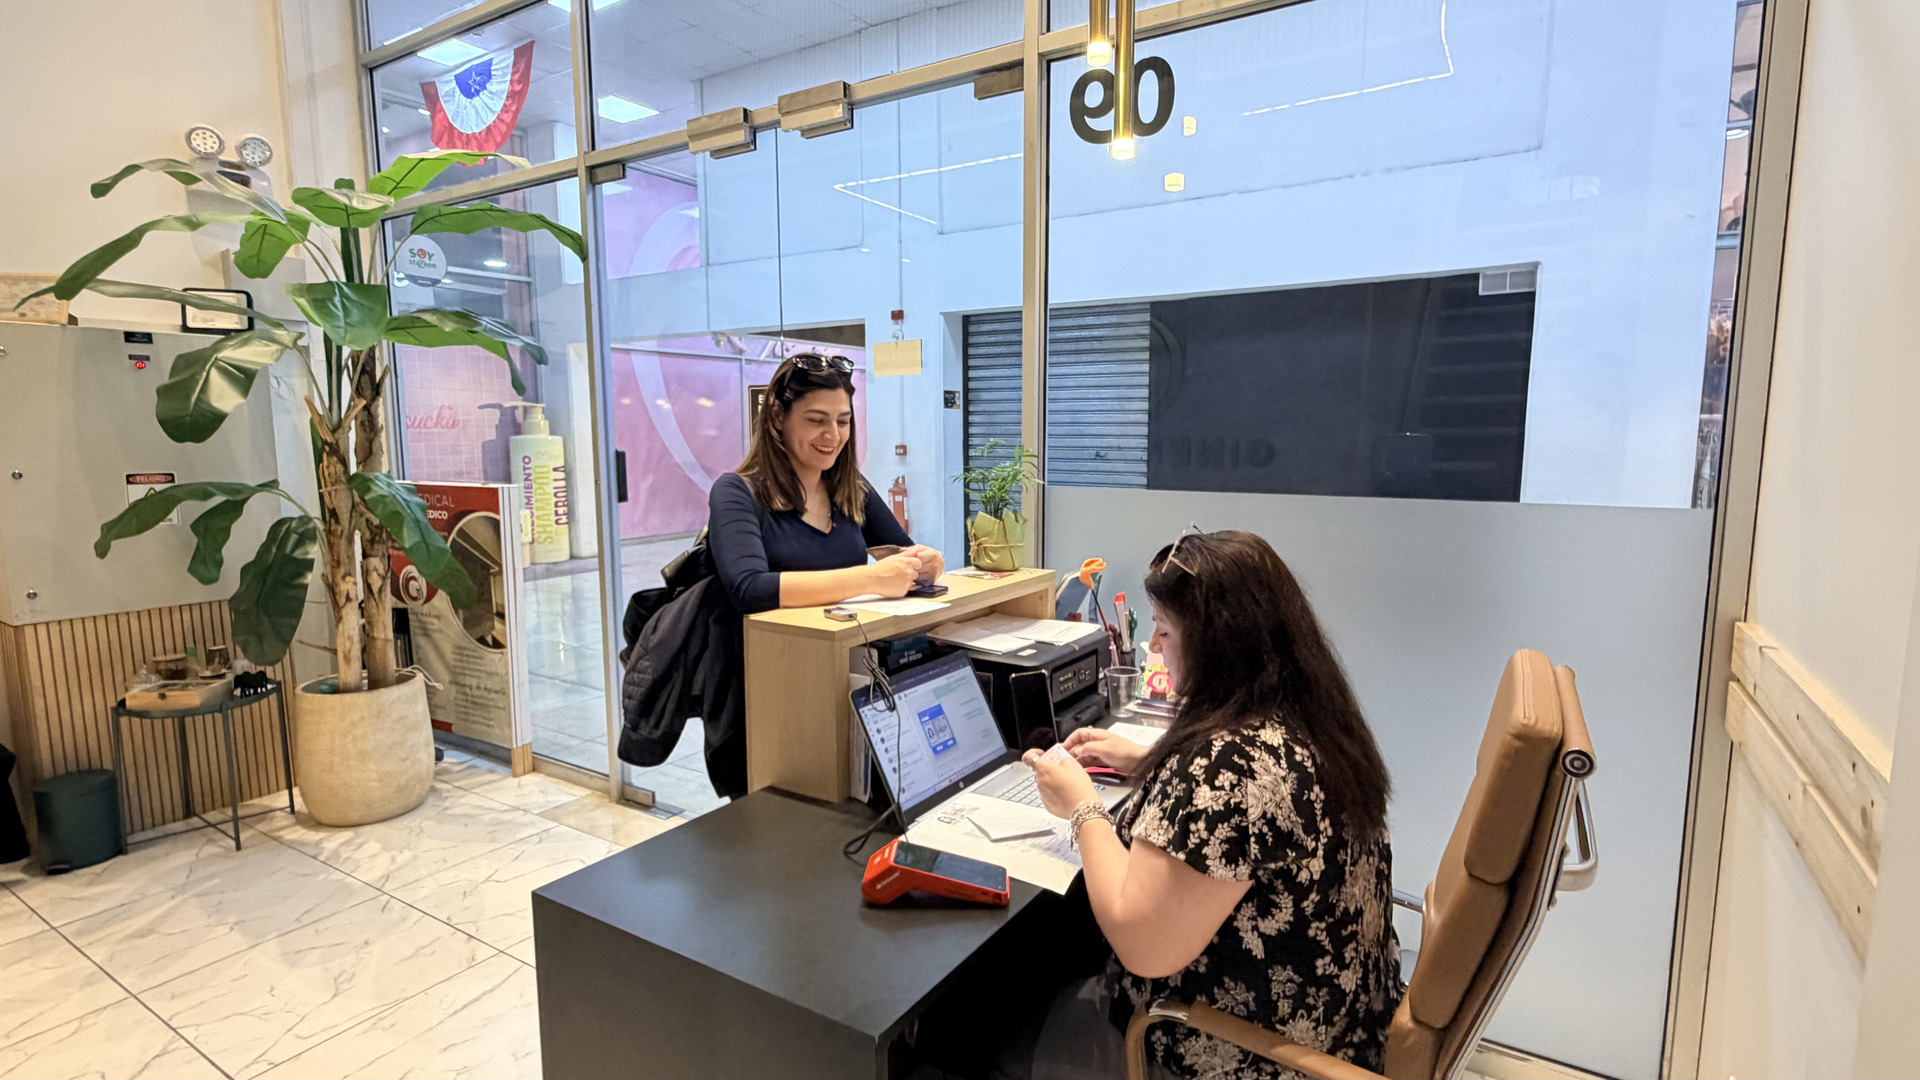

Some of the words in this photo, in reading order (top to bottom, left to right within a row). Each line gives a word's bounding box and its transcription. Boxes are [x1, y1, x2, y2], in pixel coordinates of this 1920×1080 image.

[408, 247, 435, 262] SOY
[418, 493, 456, 508] DICAL
[521, 455, 536, 545] IMIENTO
[532, 464, 555, 545] SHAMPOO
[427, 509, 449, 520] EDICO
